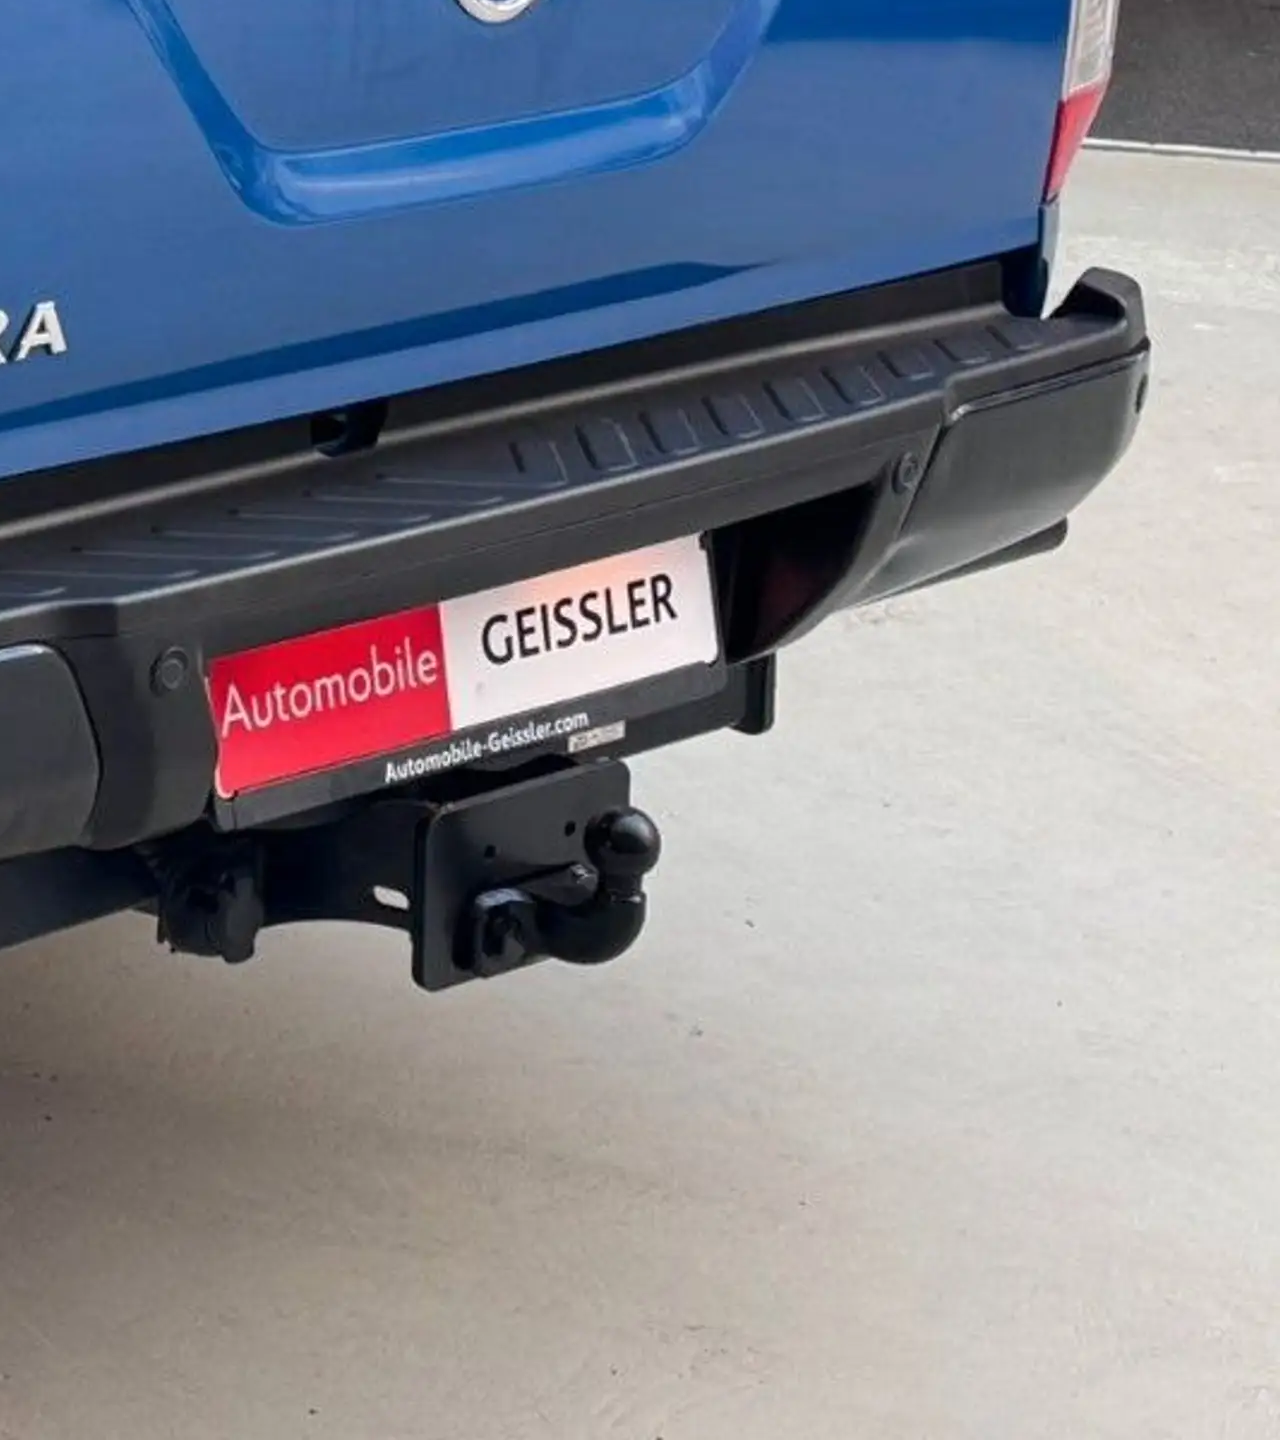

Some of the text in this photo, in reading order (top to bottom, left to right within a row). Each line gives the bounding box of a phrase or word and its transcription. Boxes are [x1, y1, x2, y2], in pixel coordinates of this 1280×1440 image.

[220, 572, 678, 737] Automobile GEISSLER
[384, 712, 590, 784] Automobile-Geissler.com
